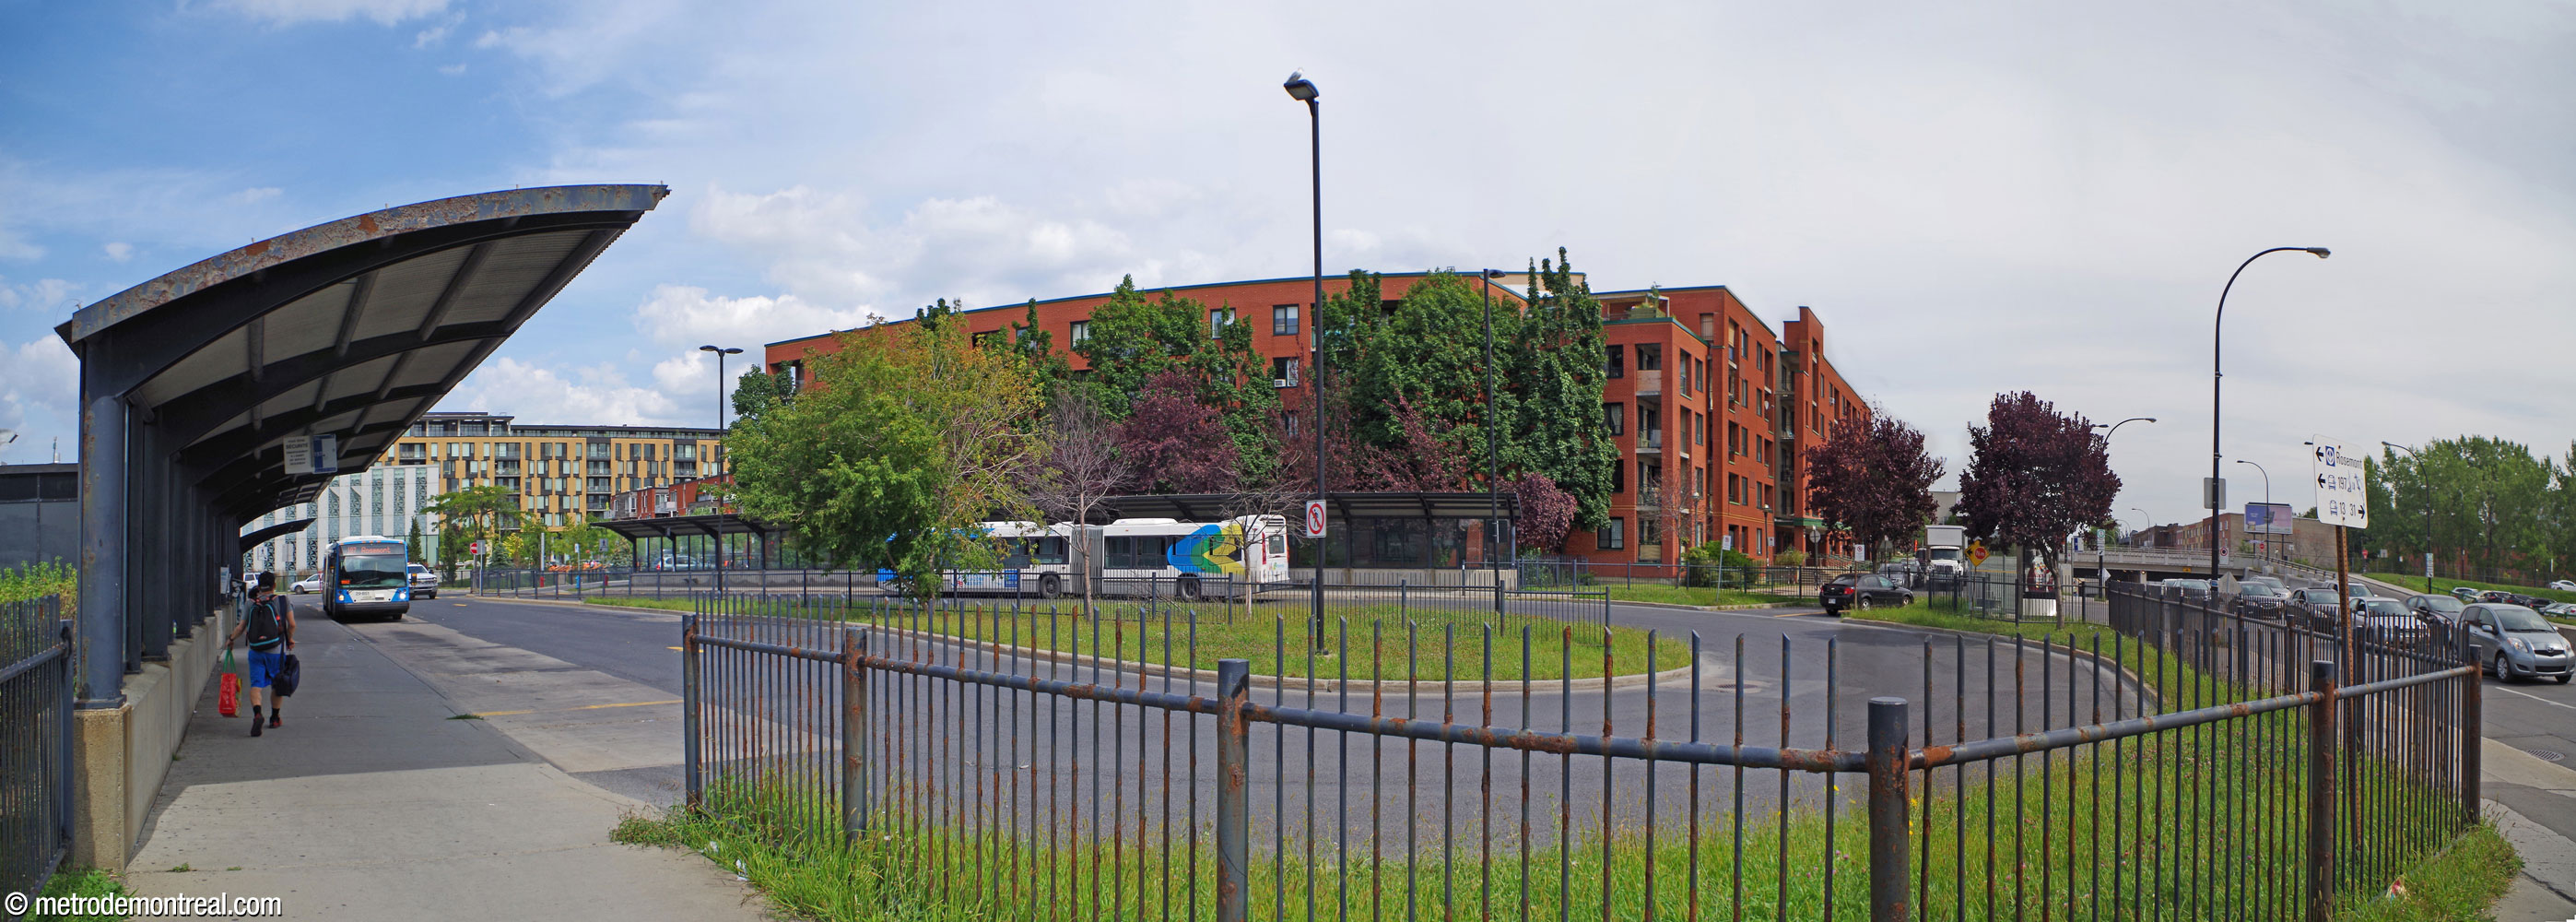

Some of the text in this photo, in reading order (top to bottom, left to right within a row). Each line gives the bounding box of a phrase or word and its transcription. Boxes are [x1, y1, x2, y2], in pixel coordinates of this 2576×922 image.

[2336, 451, 2362, 469] Rosemont
[2338, 477, 2347, 490] 197
[2339, 502, 2356, 516] 13 31
